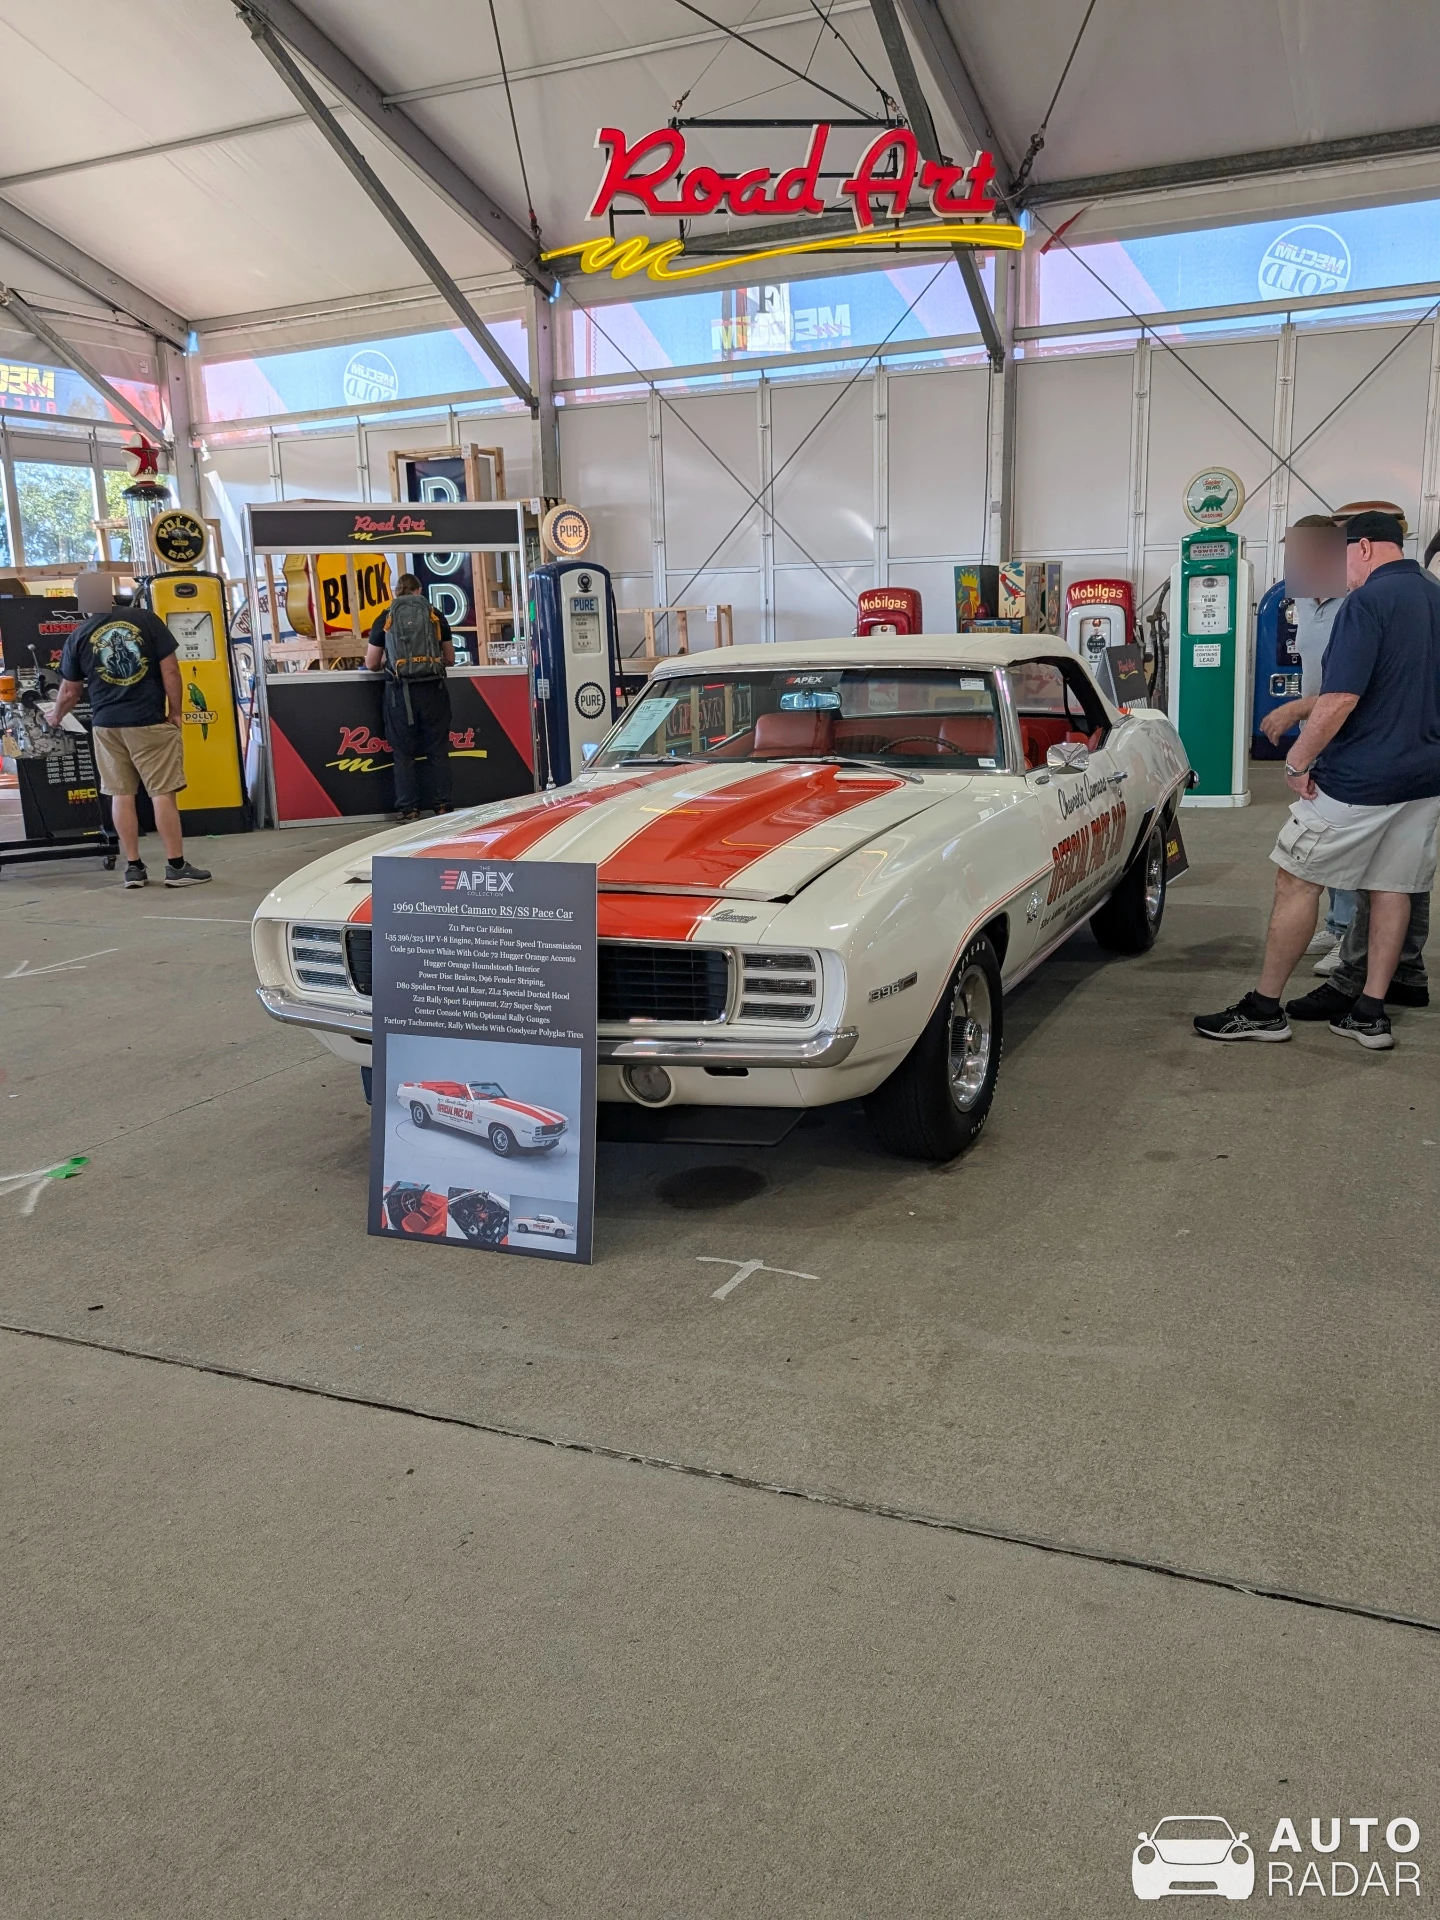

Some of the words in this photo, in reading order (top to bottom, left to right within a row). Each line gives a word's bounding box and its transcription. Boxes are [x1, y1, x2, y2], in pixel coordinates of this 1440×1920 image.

[585, 125, 831, 221] Road
[837, 128, 997, 232] Art
[158, 517, 201, 538] POLLY
[354, 515, 395, 531] Road
[397, 515, 426, 533] Art
[560, 525, 582, 537] PURE
[168, 549, 195, 559] GAS
[1071, 584, 1123, 600] Mobilgas
[574, 600, 594, 611] PURE
[861, 596, 907, 611] Mobilgas
[581, 695, 601, 706] PURE
[184, 713, 214, 721] POLLY
[449, 727, 475, 748] rt
[67, 788, 98, 800] MEC
[1083, 773, 1107, 802] Camaro
[456, 871, 514, 892] APEX
[392, 901, 414, 914] 1969
[416, 902, 458, 913] Chevrolet
[460, 904, 497, 915] Camaro
[500, 906, 530, 917] RS/SS
[532, 907, 554, 918] Pace
[556, 908, 573, 918] Car
[476, 925, 488, 933] Car
[489, 926, 512, 934] Edition
[385, 933, 397, 941] L35
[397, 934, 424, 943] 396/325
[449, 937, 473, 945] Engine,
[474, 938, 498, 946] Muncie
[516, 940, 536, 948] Speed
[537, 941, 582, 950] Transmission
[407, 947, 415, 955] 50
[416, 946, 435, 954] Dover
[436, 948, 455, 956] White
[456, 948, 472, 956] With
[500, 951, 524, 960] Hugger
[525, 952, 549, 962] Orange
[550, 954, 576, 963] Accents
[423, 959, 446, 968] Hugger
[447, 960, 470, 970] Orange
[472, 962, 513, 972] Houndstooth
[515, 964, 540, 973] Interior
[418, 970, 438, 979] Power
[439, 972, 453, 980] Disc
[454, 973, 477, 982] Brakes,
[478, 974, 492, 983] D96
[493, 976, 516, 984] Fender
[517, 977, 546, 987] Striping,
[411, 982, 436, 991] Spoilers
[470, 986, 488, 996] Rear,
[502, 989, 526, 997] Special
[526, 990, 550, 999] Ducted
[551, 992, 570, 1000] Hood
[871, 982, 900, 1002] 396
[426, 995, 442, 1005] Rally
[443, 997, 460, 1006] Sport
[462, 998, 499, 1008] Equipment,
[500, 1001, 512, 1010] Z27
[513, 1001, 532, 1011] Super
[533, 1003, 552, 1012] Sport
[414, 1007, 435, 1015] Center
[436, 1008, 461, 1017] Console
[462, 1010, 478, 1018] With
[479, 1011, 507, 1020] Optional
[508, 1014, 525, 1023] Rally
[526, 1015, 550, 1024] Gauges
[384, 1017, 407, 1026] Factory
[408, 1018, 446, 1028] Tachometer,
[448, 1022, 464, 1031] Rally
[465, 1023, 488, 1031] Wheels
[506, 1025, 537, 1036] Goodyear
[538, 1028, 565, 1038] Polyglas
[567, 1030, 584, 1039] Tires
